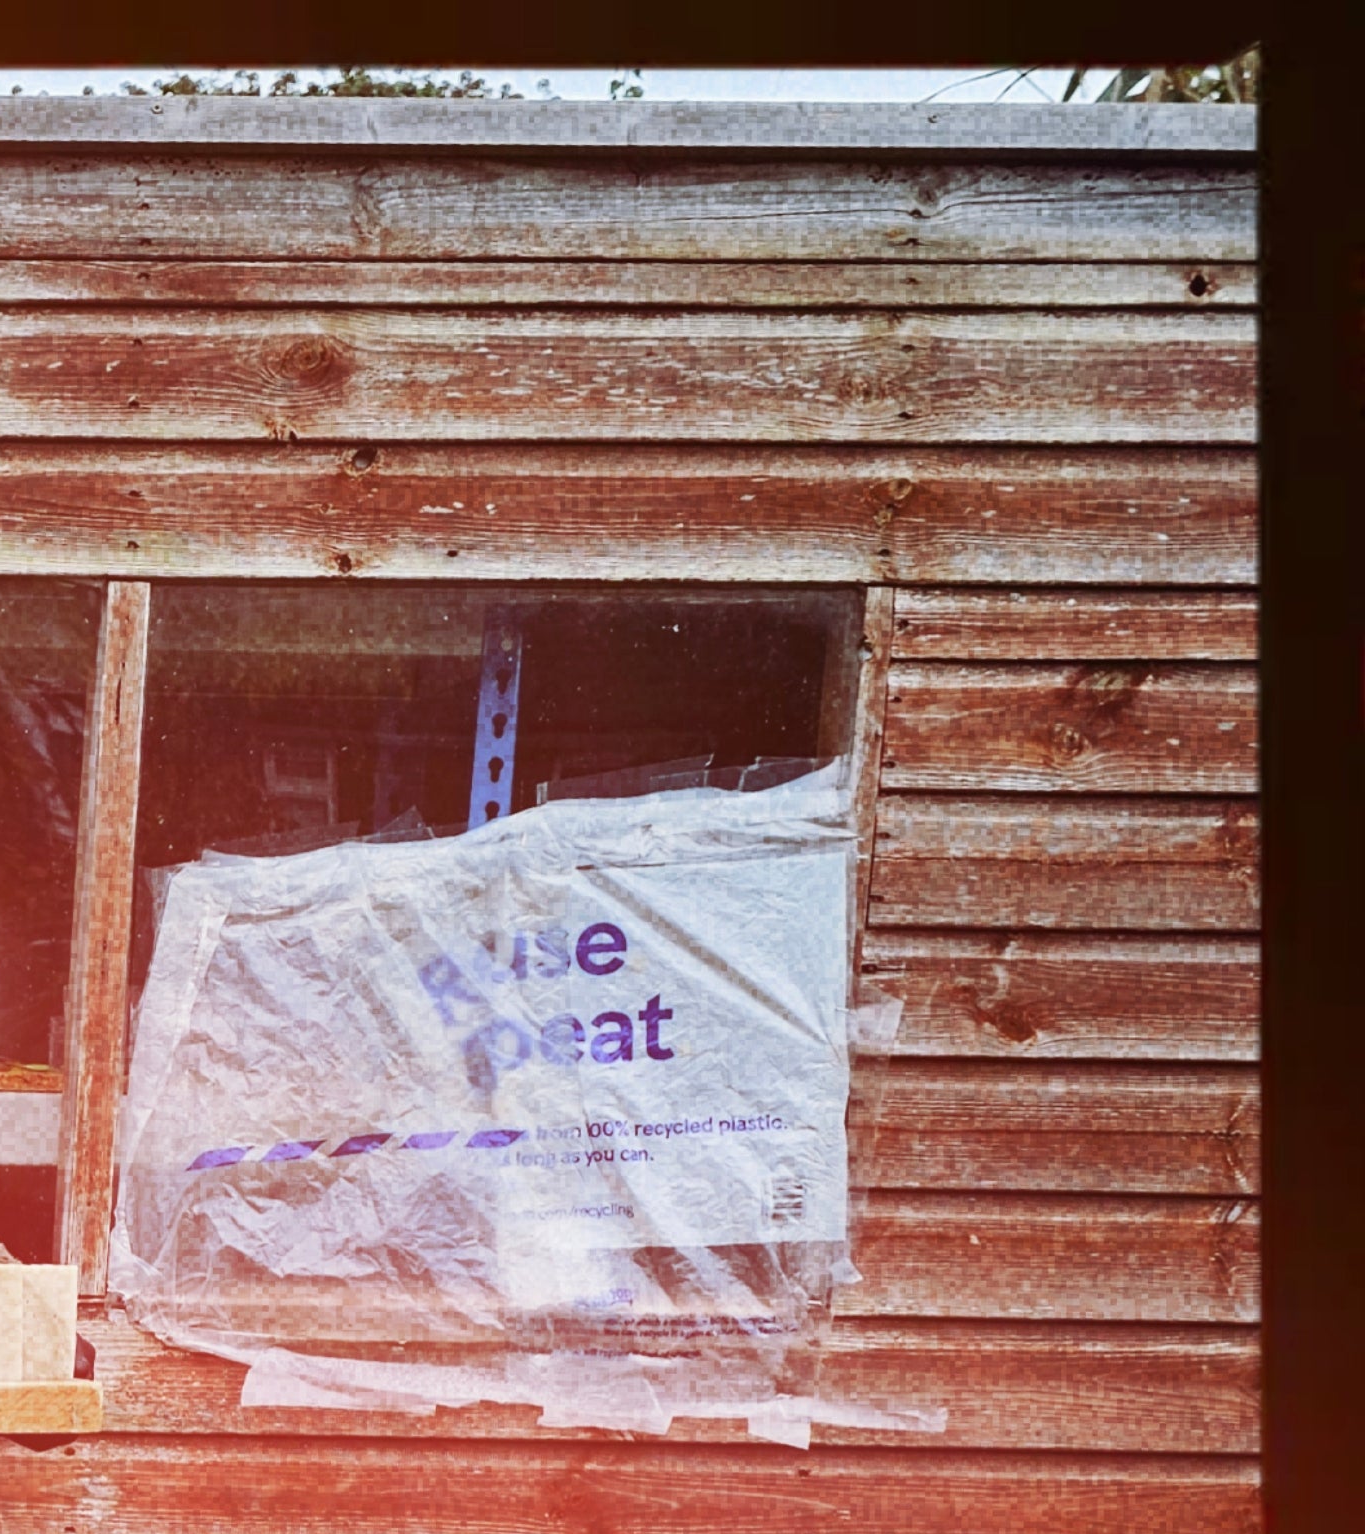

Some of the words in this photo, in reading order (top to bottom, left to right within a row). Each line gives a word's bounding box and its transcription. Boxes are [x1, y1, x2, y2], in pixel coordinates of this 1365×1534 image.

[536, 1125, 582, 1141] from
[634, 1117, 714, 1140] recycled
[718, 1114, 789, 1134] plastic.
[516, 1151, 556, 1169] long
[560, 1150, 581, 1165] as
[585, 1149, 615, 1167] you
[619, 1149, 655, 1162] can.
